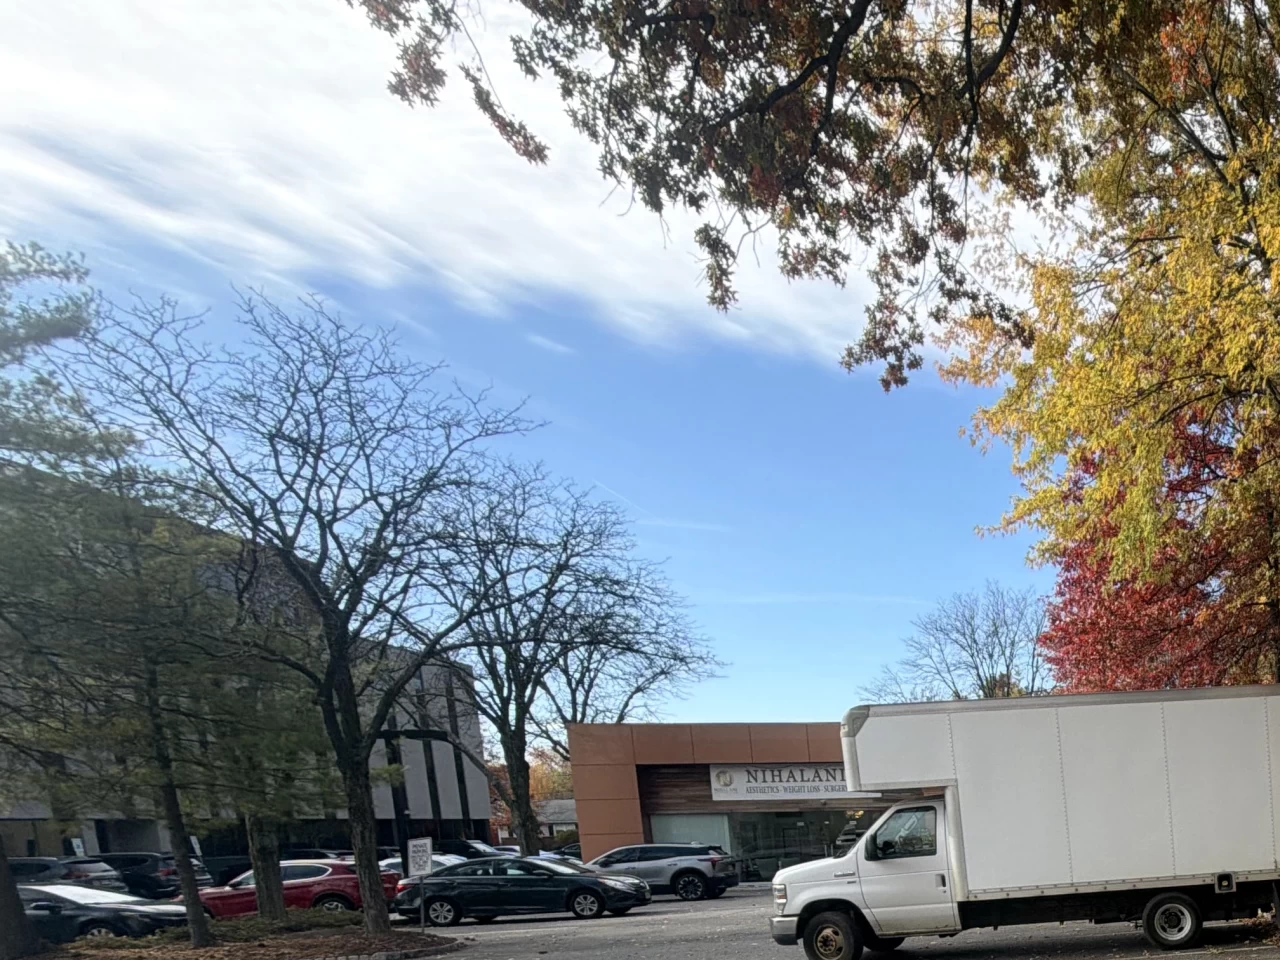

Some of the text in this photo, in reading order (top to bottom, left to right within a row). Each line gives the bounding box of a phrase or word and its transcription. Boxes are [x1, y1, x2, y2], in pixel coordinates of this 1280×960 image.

[745, 768, 847, 783] NIHALANI
[746, 786, 780, 794] AESTHETICS
[783, 785, 806, 793] WEIGHT
[807, 785, 821, 793] LOSS
